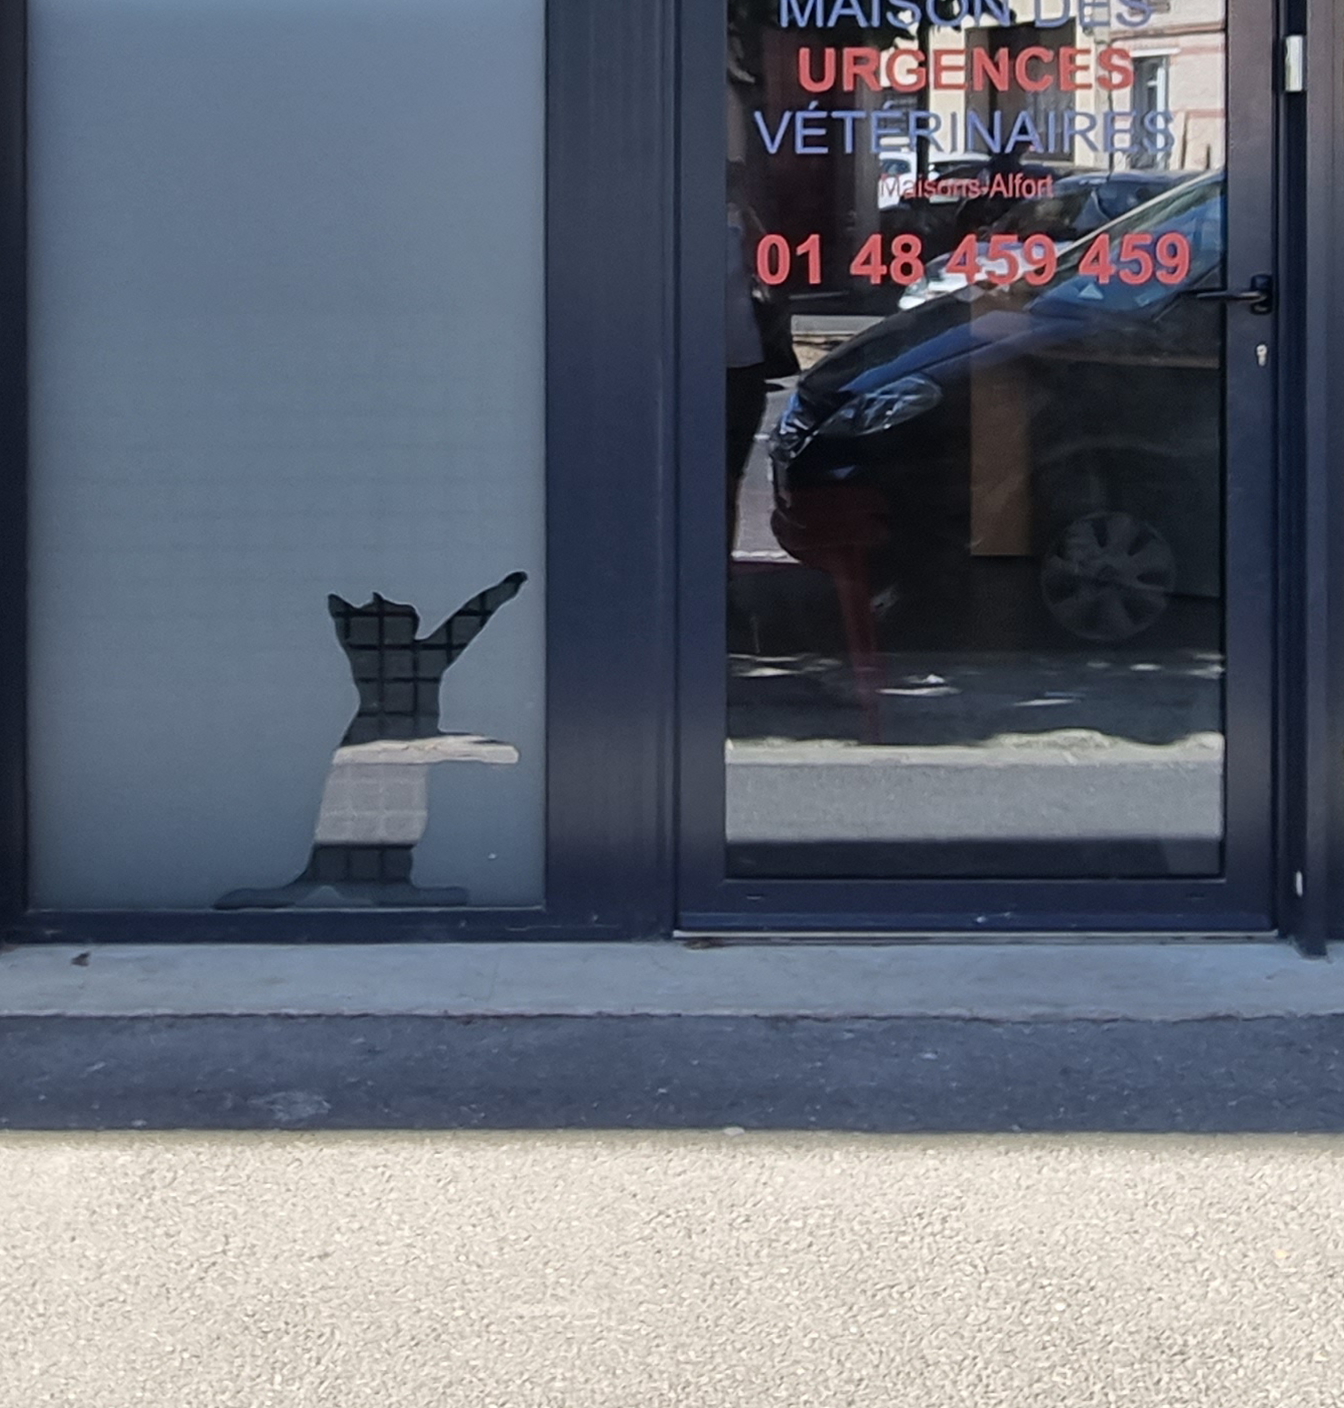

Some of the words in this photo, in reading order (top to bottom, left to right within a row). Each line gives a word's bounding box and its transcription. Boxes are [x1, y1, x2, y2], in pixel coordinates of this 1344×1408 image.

[797, 46, 1135, 93] URGENCES
[753, 100, 1175, 155] VÉTÉRINAIRES
[879, 172, 1054, 200] Maisons-Alfort
[756, 234, 823, 286] 01
[849, 233, 924, 286] 48
[946, 233, 1058, 285] 459
[1078, 233, 1192, 285] 459
